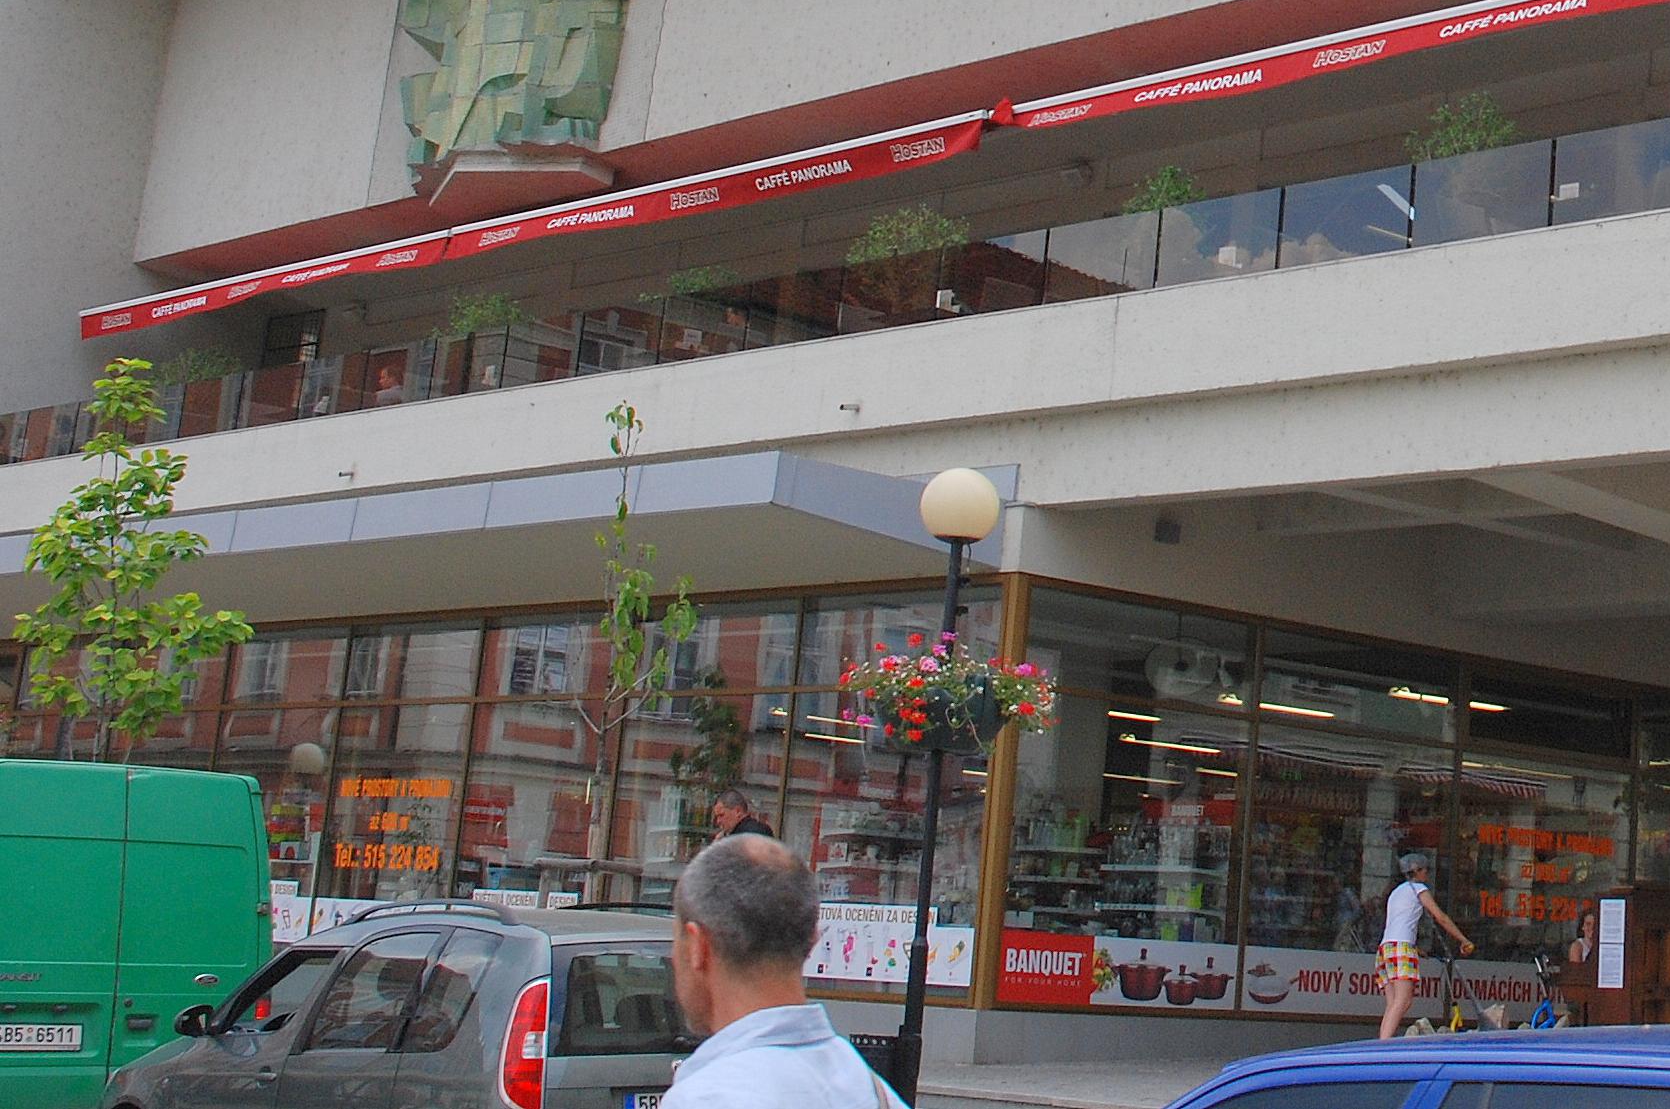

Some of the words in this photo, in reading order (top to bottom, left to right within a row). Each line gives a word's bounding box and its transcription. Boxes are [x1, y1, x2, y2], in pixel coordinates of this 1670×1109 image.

[1313, 40, 1386, 67] HOSTAN
[1182, 69, 1262, 96] PANORAMA
[578, 206, 634, 224] PANORAMA
[670, 188, 719, 210] HOSTAN
[755, 172, 790, 191] CAFFÉ
[791, 160, 851, 184] PANORAMA
[891, 137, 945, 162] HOSTAN
[363, 843, 386, 869] 515
[389, 844, 412, 869] 224
[818, 905, 842, 921] TOVÁ
[887, 909, 898, 923] ZA
[1298, 966, 1344, 993] NOVÝ
[1349, 973, 1441, 998] SORENT
[0, 1027, 24, 1043] B5
[36, 1027, 74, 1043] 6511
